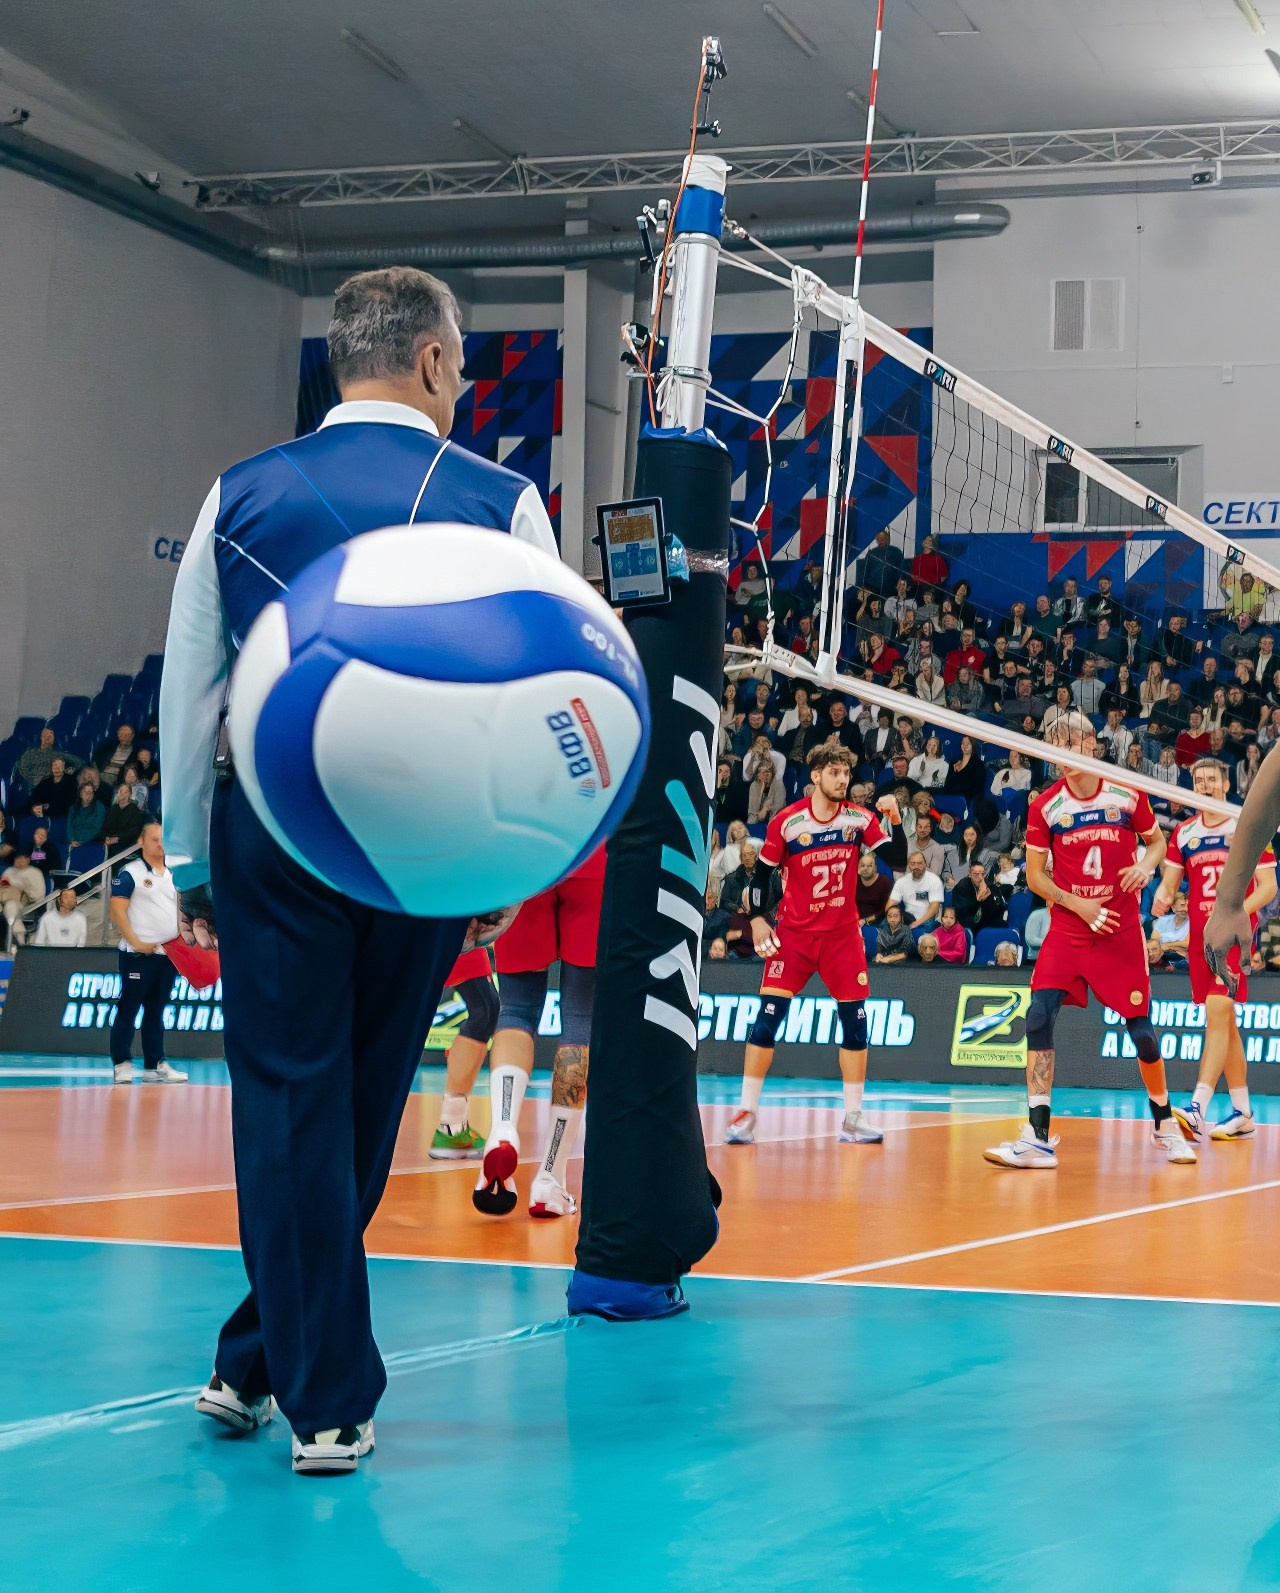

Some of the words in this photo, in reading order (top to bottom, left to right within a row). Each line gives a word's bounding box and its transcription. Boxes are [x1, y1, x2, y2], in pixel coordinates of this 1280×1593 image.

[926, 361, 954, 391] PARI
[1050, 437, 1072, 461] PARI
[1082, 845, 1103, 880] 4
[811, 860, 847, 899] 23
[1201, 865, 1225, 898] 2
